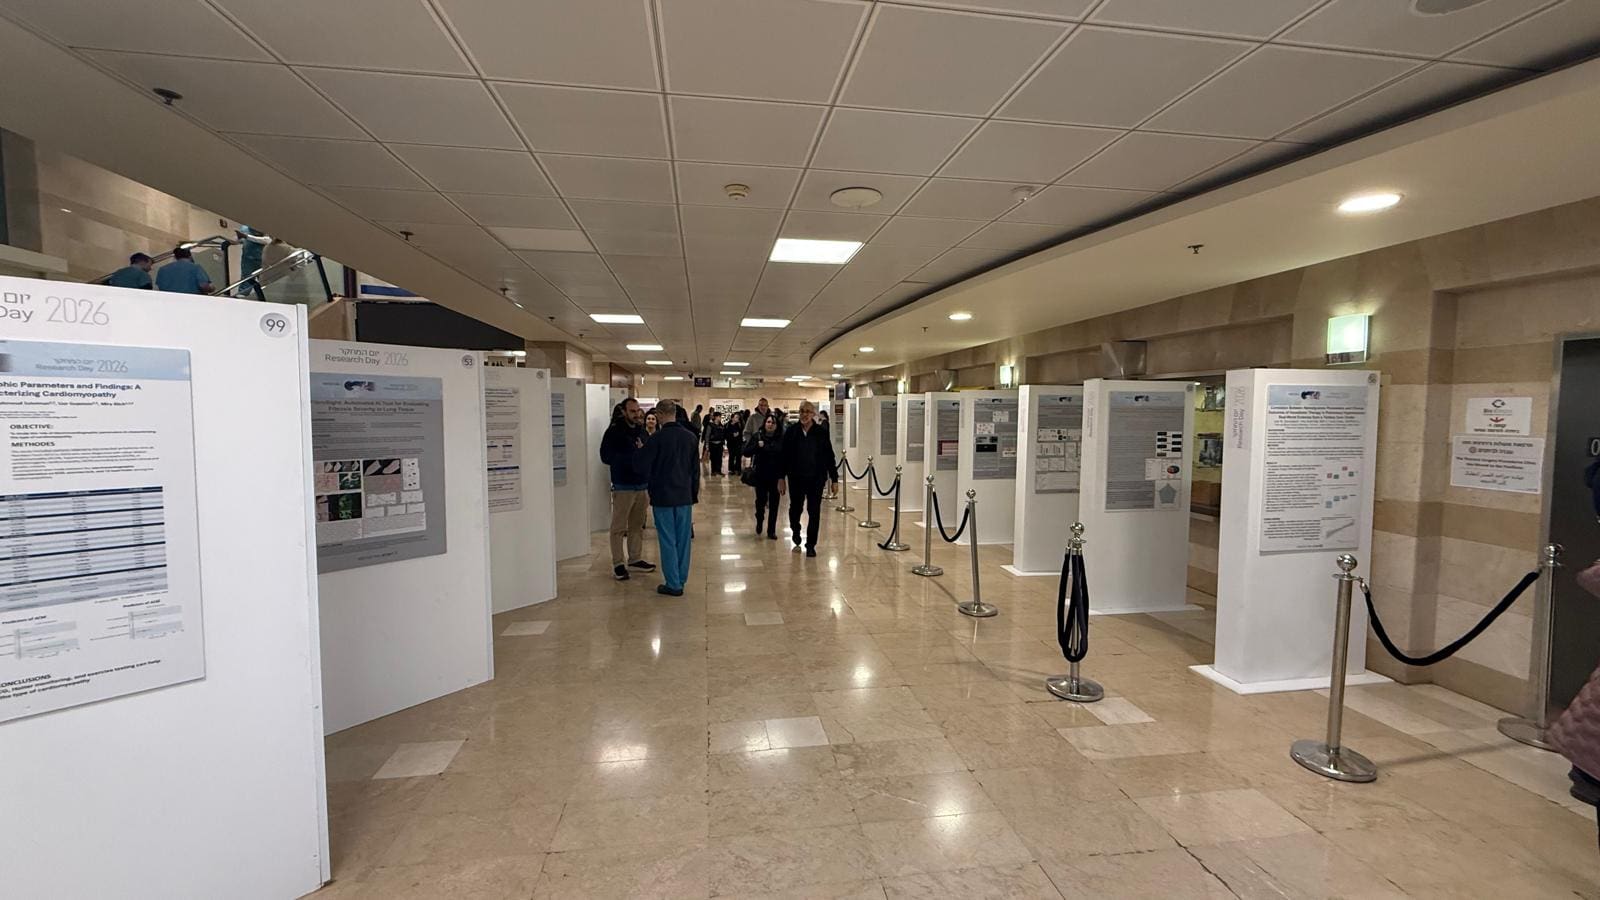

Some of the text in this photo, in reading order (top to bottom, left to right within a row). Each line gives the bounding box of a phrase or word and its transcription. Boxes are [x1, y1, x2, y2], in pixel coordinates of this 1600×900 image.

[4, 292, 31, 304] יום
[45, 296, 110, 325] 2026
[266, 318, 286, 332] 99
[325, 352, 409, 366] Research Day 2026
[464, 358, 473, 366] 53
[97, 359, 128, 373] 2026
[20, 381, 75, 389] Parameters
[76, 382, 94, 390] and
[95, 383, 133, 391] Findings:
[42, 390, 117, 399] Cardiomyopathy
[0, 674, 51, 687] ONCLUSIONS
